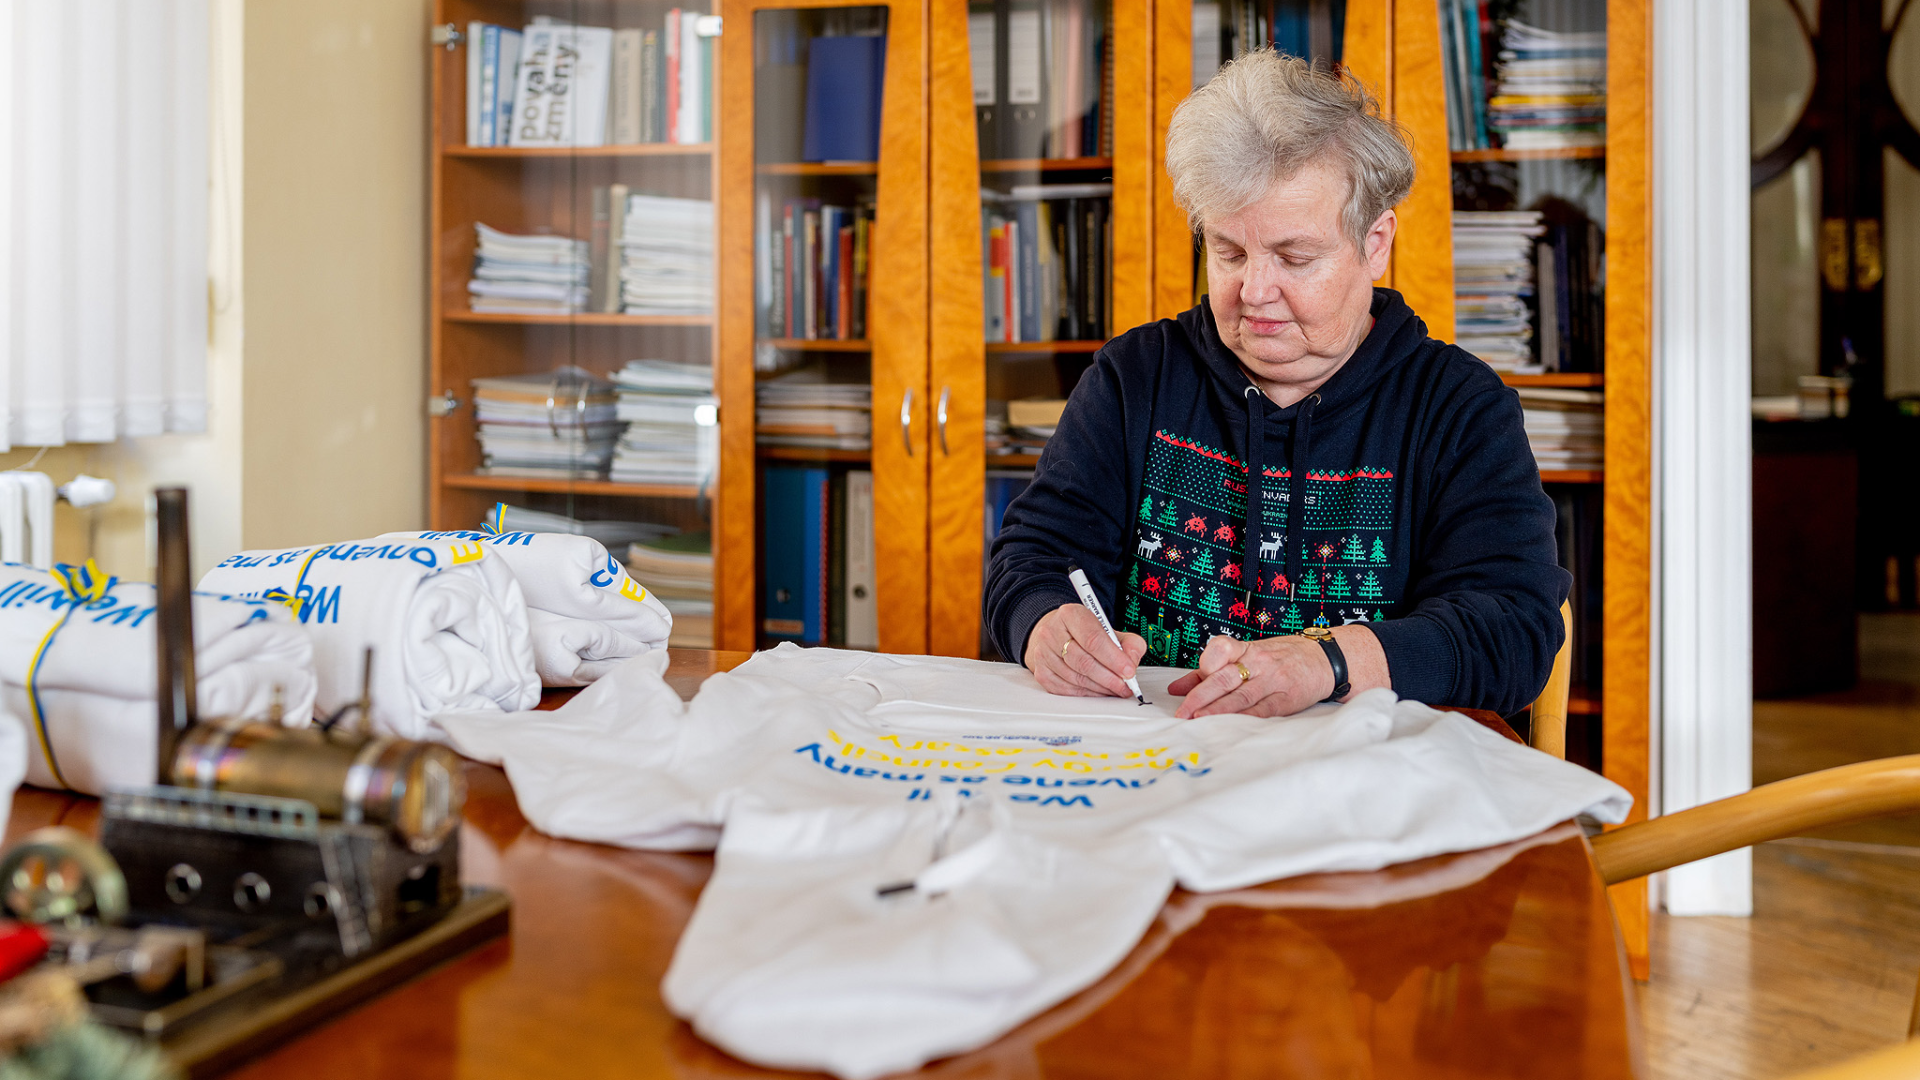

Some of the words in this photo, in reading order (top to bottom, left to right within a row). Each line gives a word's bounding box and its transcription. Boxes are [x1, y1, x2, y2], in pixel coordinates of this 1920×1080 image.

[520, 33, 552, 141] povaha
[546, 44, 582, 142] změny
[267, 548, 310, 568] as
[312, 543, 442, 575] onvene
[795, 742, 925, 783] many
[1002, 762, 1212, 789] nvene
[1032, 751, 1199, 774] nrgy
[940, 774, 988, 784] as
[1009, 793, 1095, 809] We
